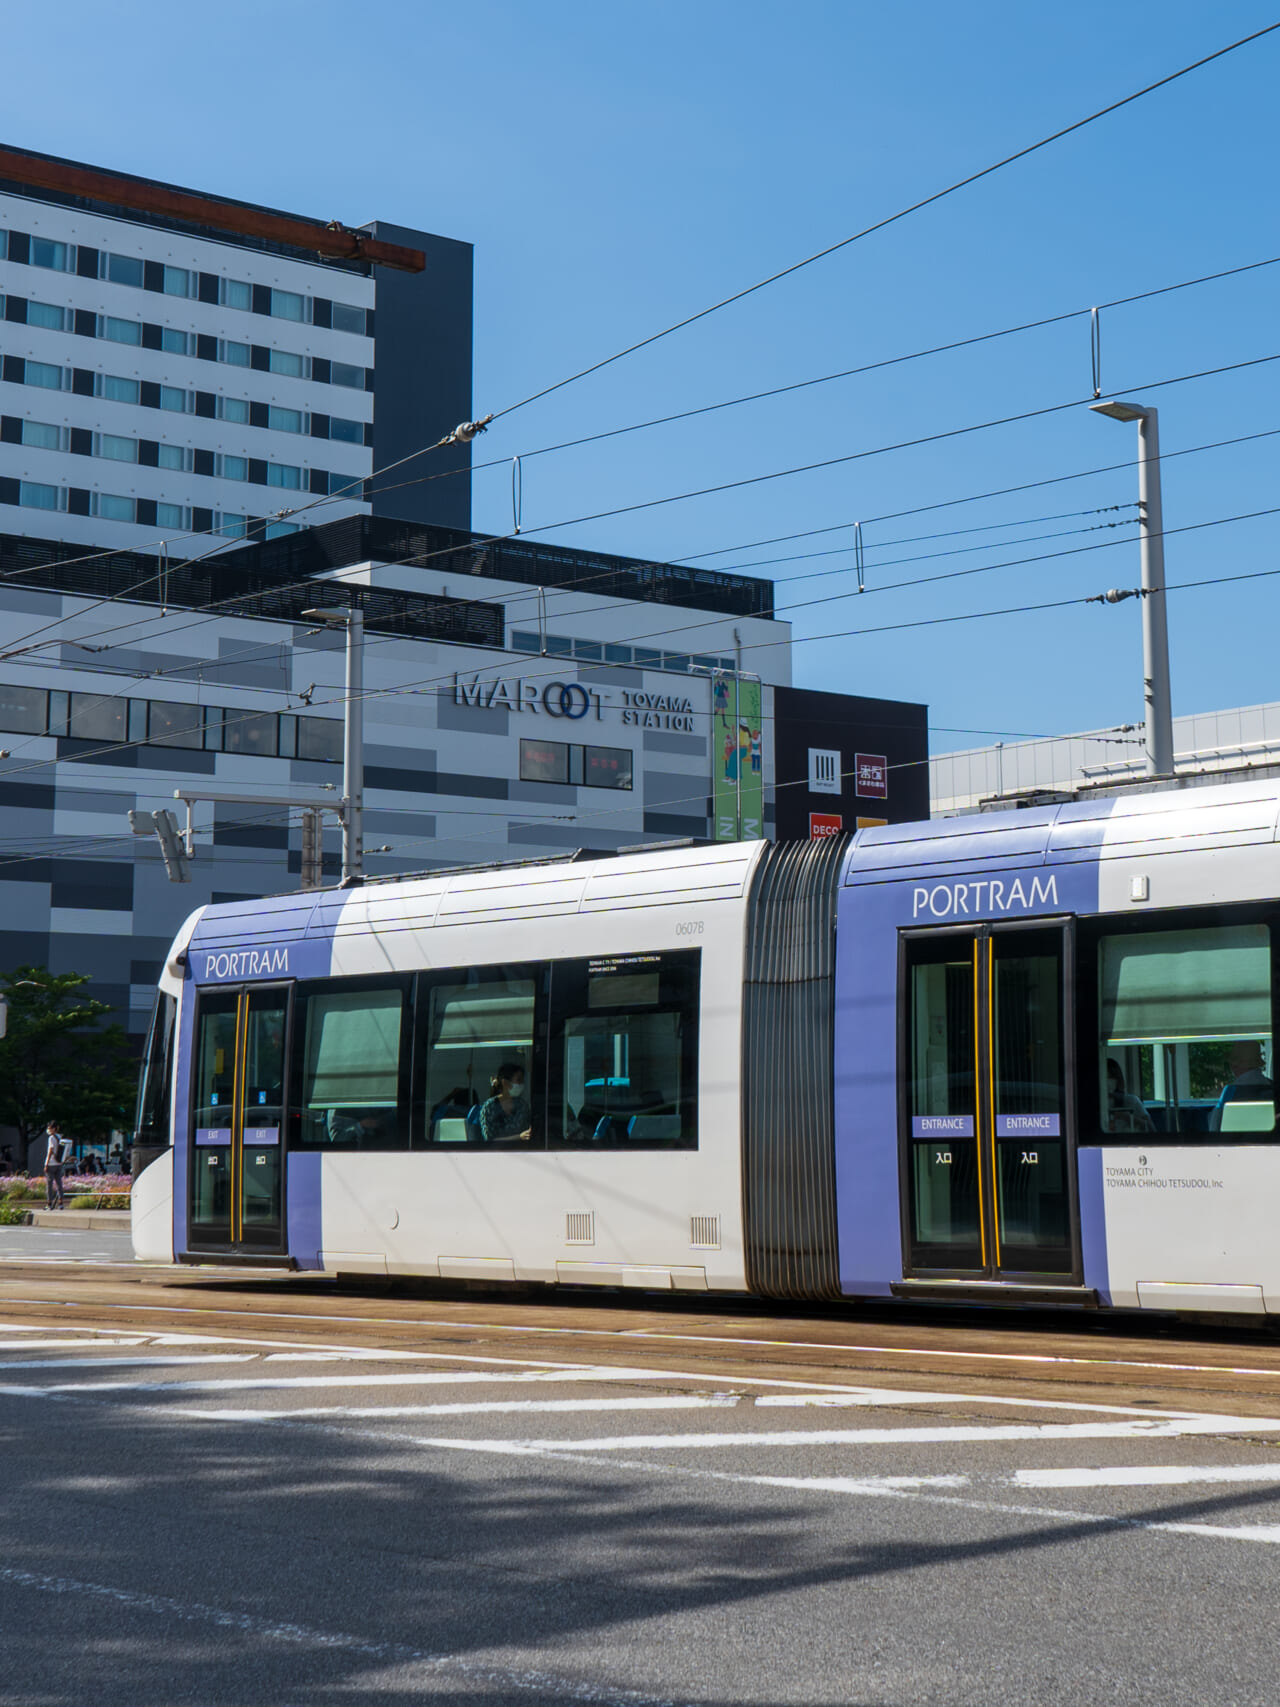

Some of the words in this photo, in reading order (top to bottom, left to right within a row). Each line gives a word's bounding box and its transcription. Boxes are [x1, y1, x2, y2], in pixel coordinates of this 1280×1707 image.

[454, 672, 611, 720] MAROOT
[622, 690, 693, 713] TOYAMA
[622, 710, 694, 732] STATION
[813, 825, 839, 835] DECO
[913, 874, 1059, 918] PORTRAM
[675, 920, 705, 936] 0607B
[205, 947, 289, 978] PORTRAM
[921, 1118, 964, 1130] ENTRANCE
[1006, 1116, 1051, 1129] ENTRANCE
[935, 1152, 952, 1164] 入口
[1021, 1152, 1038, 1164] 入口
[1106, 1167, 1136, 1176] TOYAMA
[1137, 1167, 1154, 1176] CITY
[1106, 1179, 1137, 1188] TOYAMA
[1137, 1179, 1168, 1188] CHIHOU
